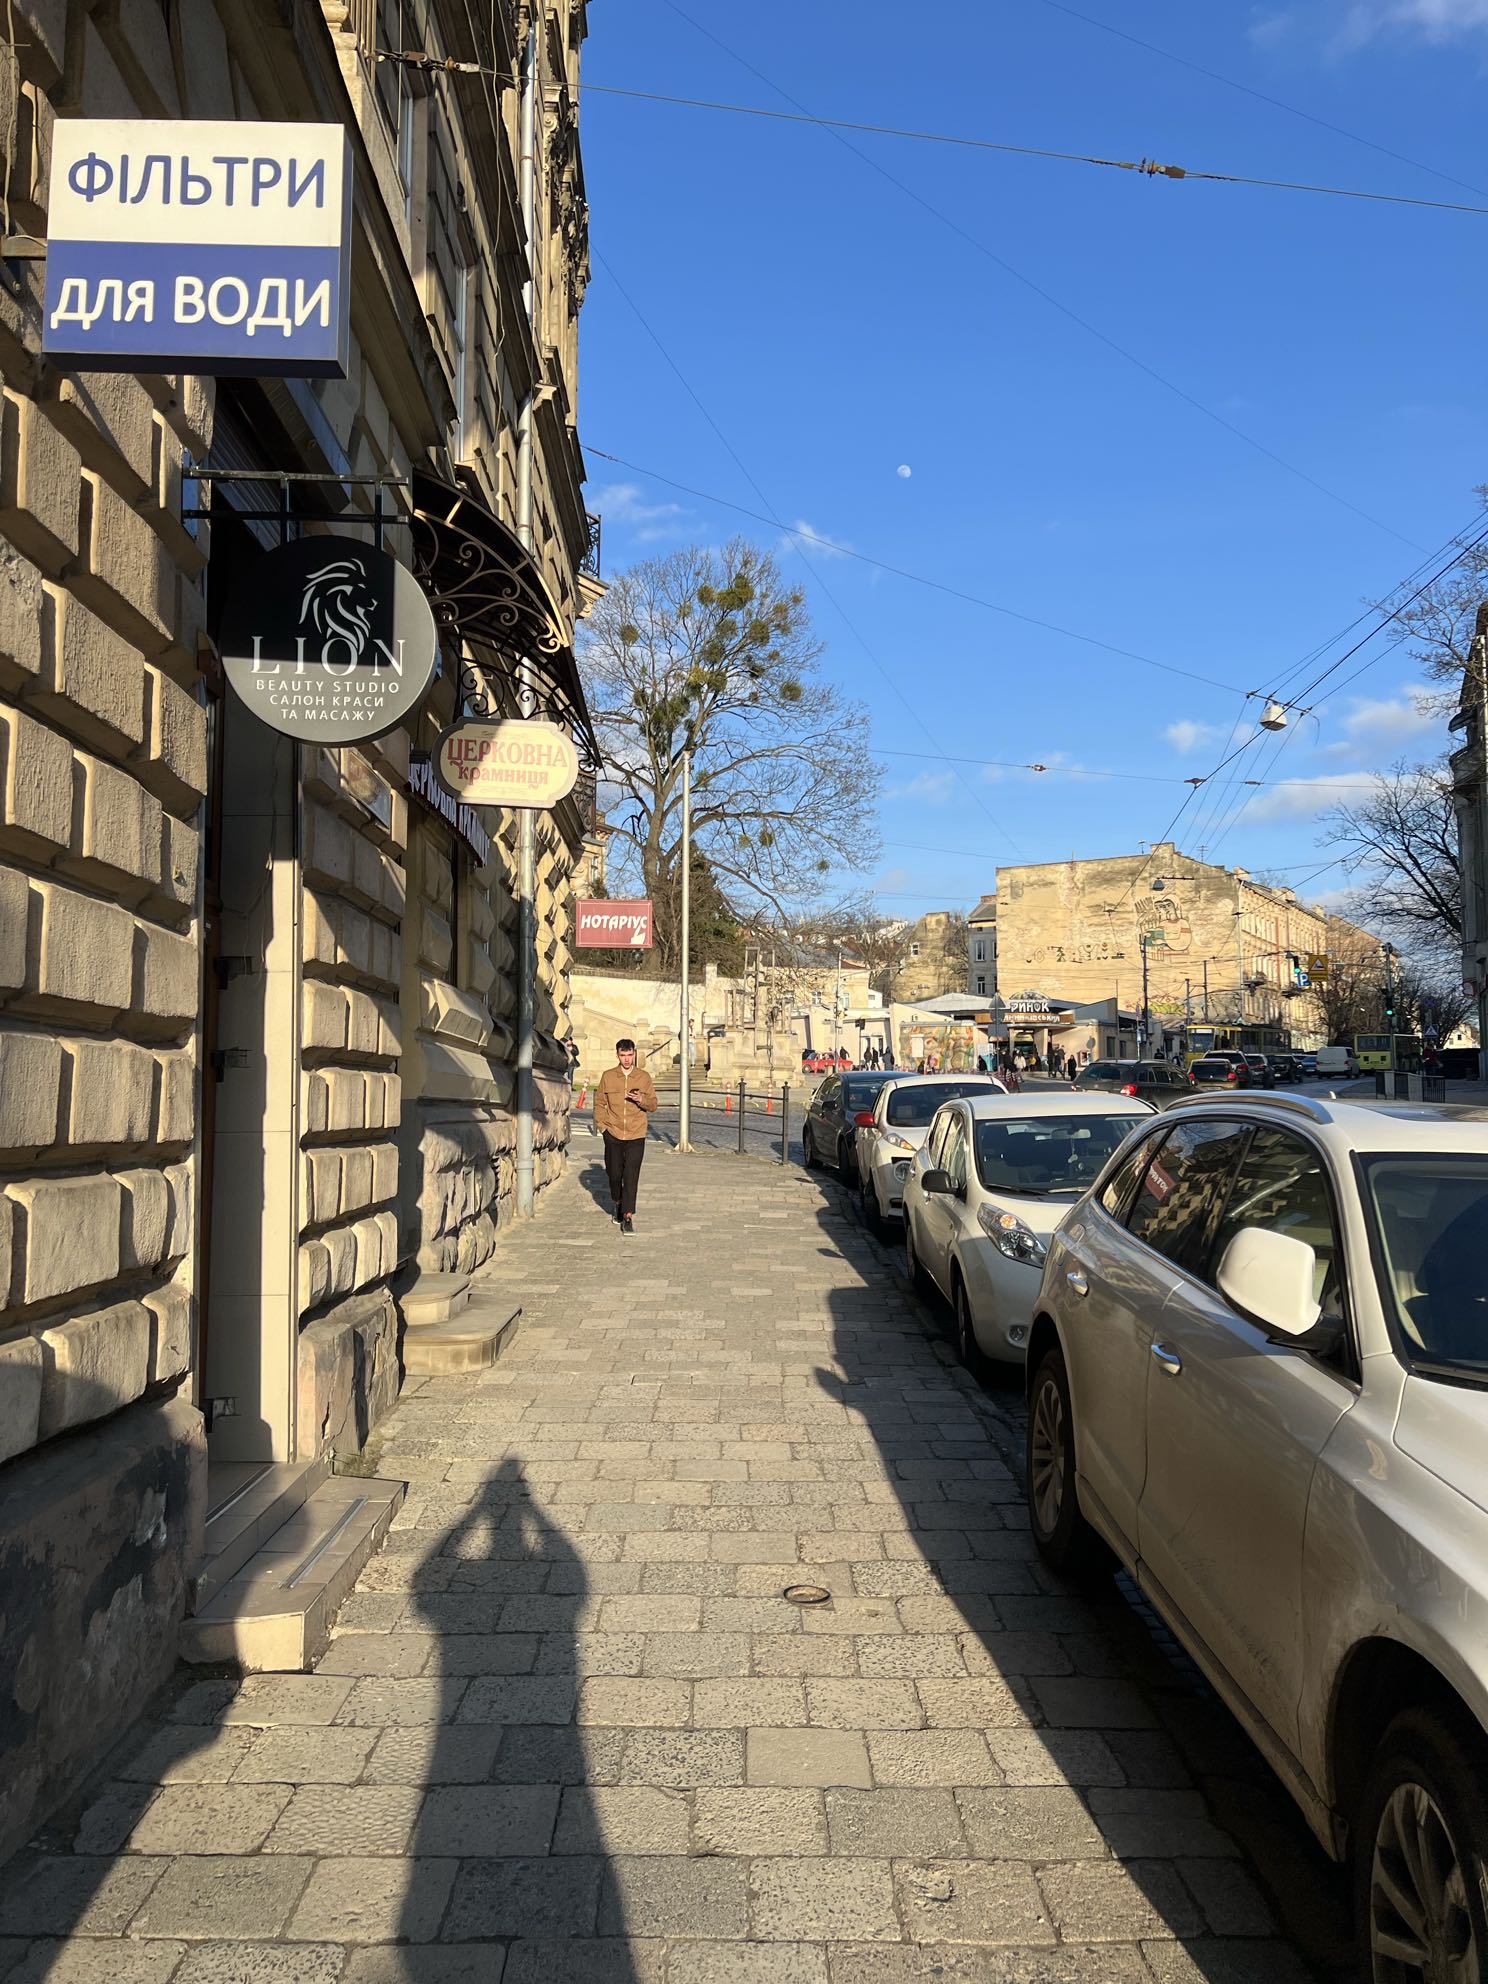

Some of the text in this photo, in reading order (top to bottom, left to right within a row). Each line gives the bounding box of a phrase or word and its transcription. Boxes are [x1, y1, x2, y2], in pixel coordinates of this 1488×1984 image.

[68, 152, 325, 208] ФІЛЬТРИ
[174, 276, 330, 337] ВОДИ
[250, 636, 406, 677] LION
[256, 679, 400, 694] BEAUTY STUDIO
[269, 694, 384, 707] САЛОН КРАСИ
[281, 708, 375, 721] ТА МАСАЖУ
[447, 738, 568, 767] ЦЕРКОВНА
[581, 914, 648, 932] НОТАРІУС
[1010, 1002, 1050, 1013] РИНОК
